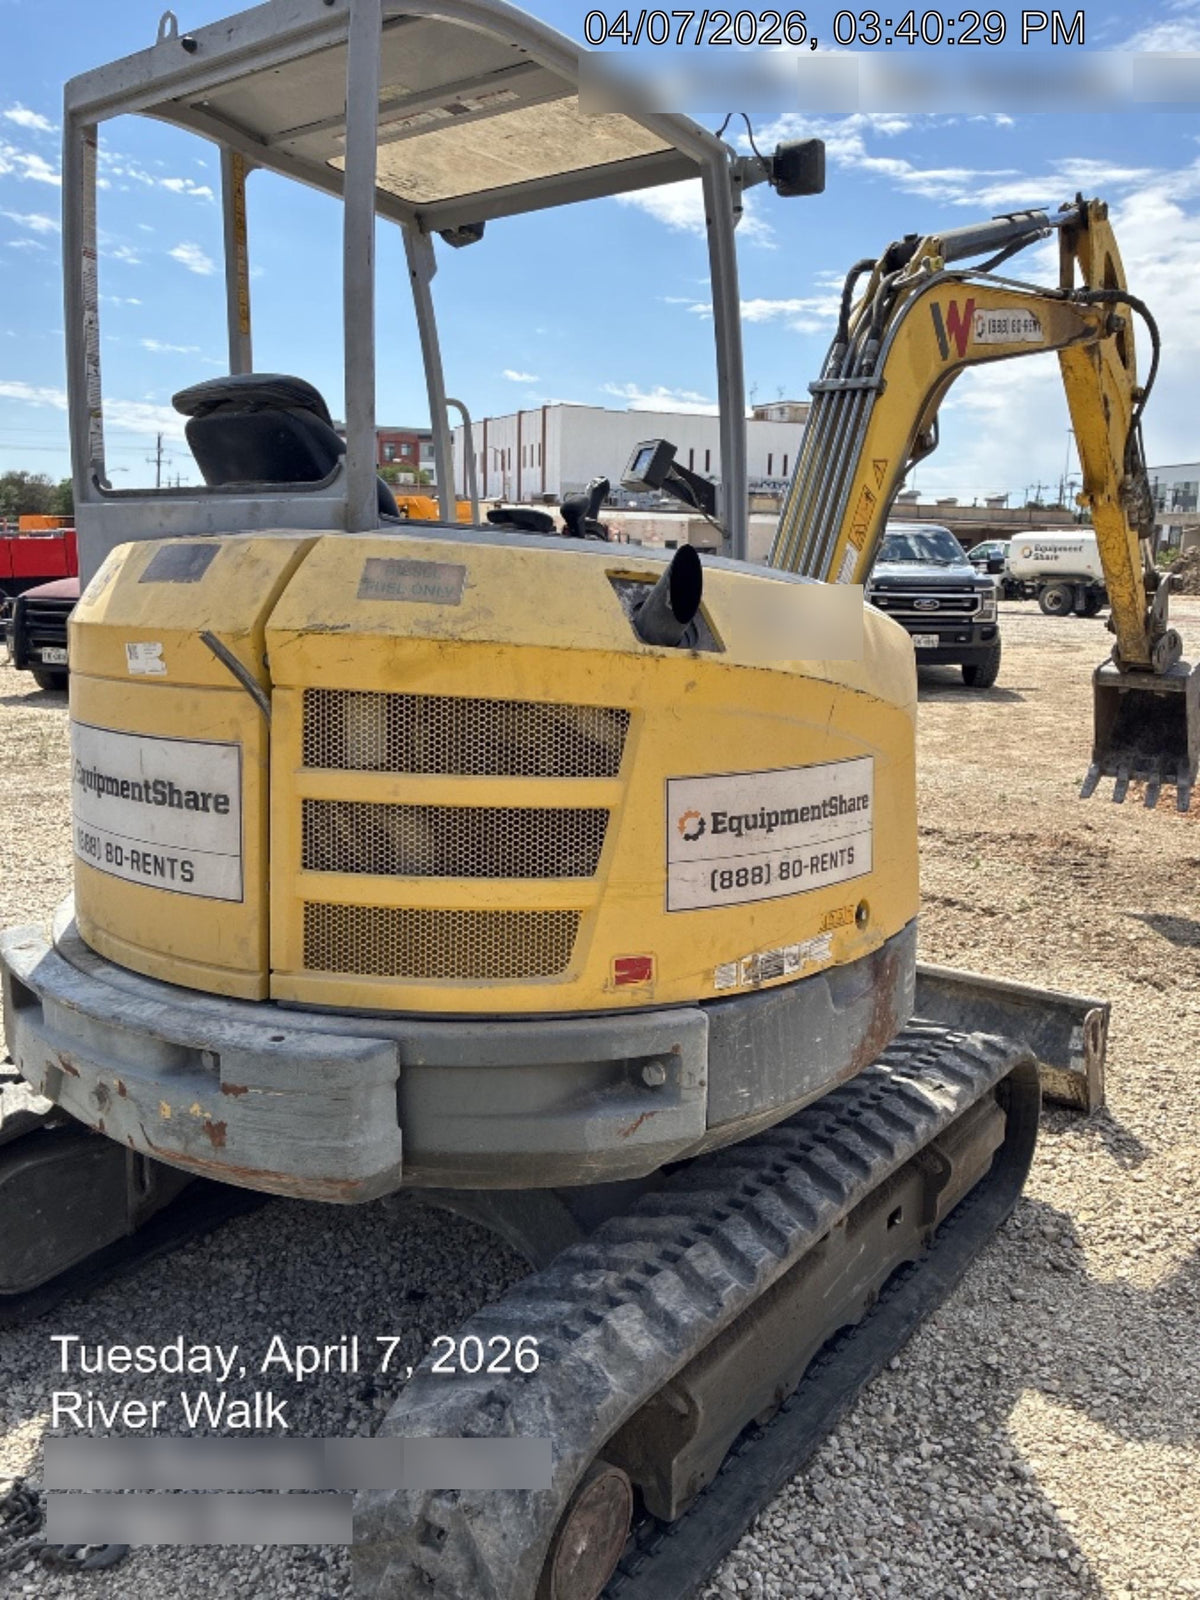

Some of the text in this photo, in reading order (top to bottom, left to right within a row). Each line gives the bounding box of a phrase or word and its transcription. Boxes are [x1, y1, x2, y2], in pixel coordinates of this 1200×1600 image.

[710, 793, 870, 838] EquipmentShare
[105, 842, 195, 883] 80-RENTS
[710, 846, 856, 893] (888) 80-RENTS
